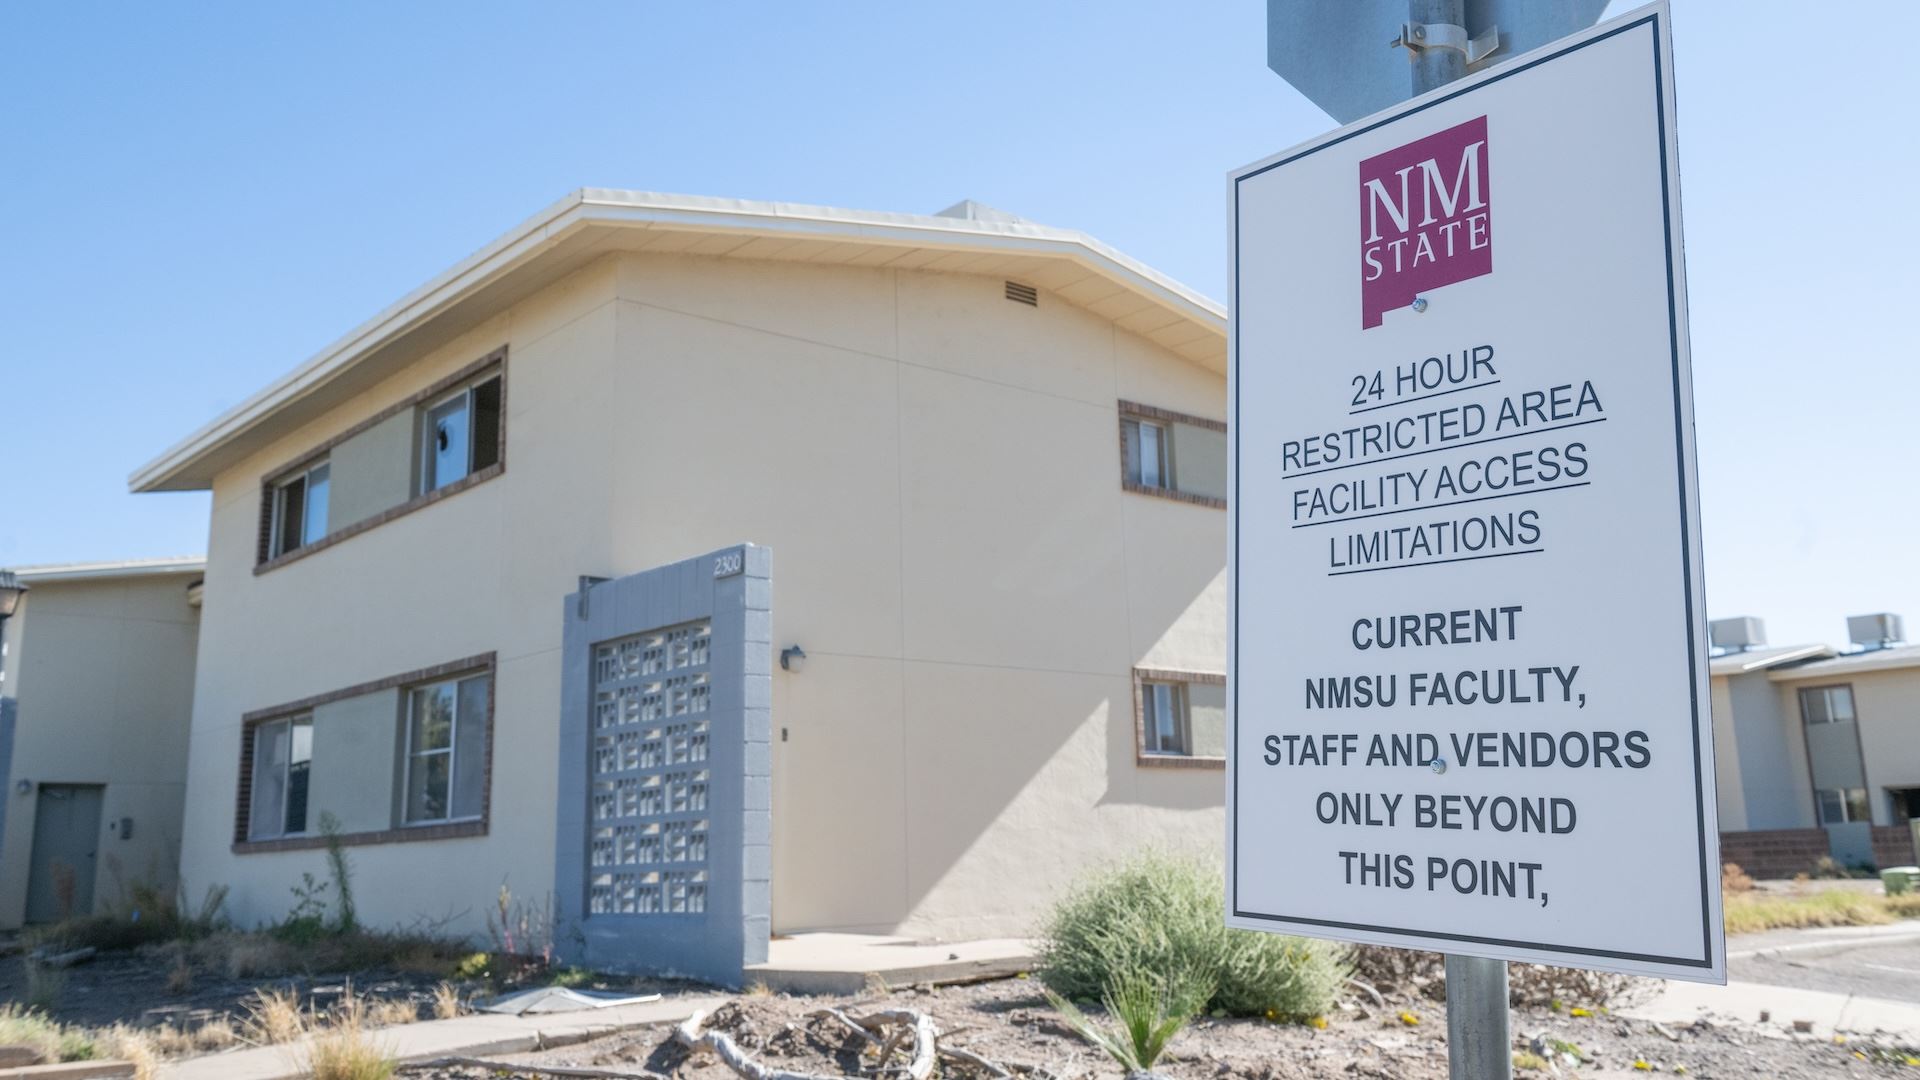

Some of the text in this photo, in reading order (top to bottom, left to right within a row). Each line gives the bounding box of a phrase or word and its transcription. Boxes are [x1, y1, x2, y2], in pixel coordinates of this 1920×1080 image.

[1364, 141, 1487, 245] NM
[1365, 213, 1489, 281] STATE
[1351, 345, 1496, 406] 24 HOUR
[1283, 380, 1603, 471] RESTRICTED AREA
[1293, 442, 1589, 520] FACILITY ACCESS
[713, 554, 741, 576] 2300
[1331, 509, 1541, 568] LIMITATIONS
[1352, 605, 1522, 650] CURRENT
[1306, 666, 1586, 709] NMSU FACULTY,
[1263, 731, 1651, 768] STAFF AND VENDORS
[1316, 792, 1576, 834] ONLY BEYOND
[1339, 851, 1548, 907] THIS POINT,
